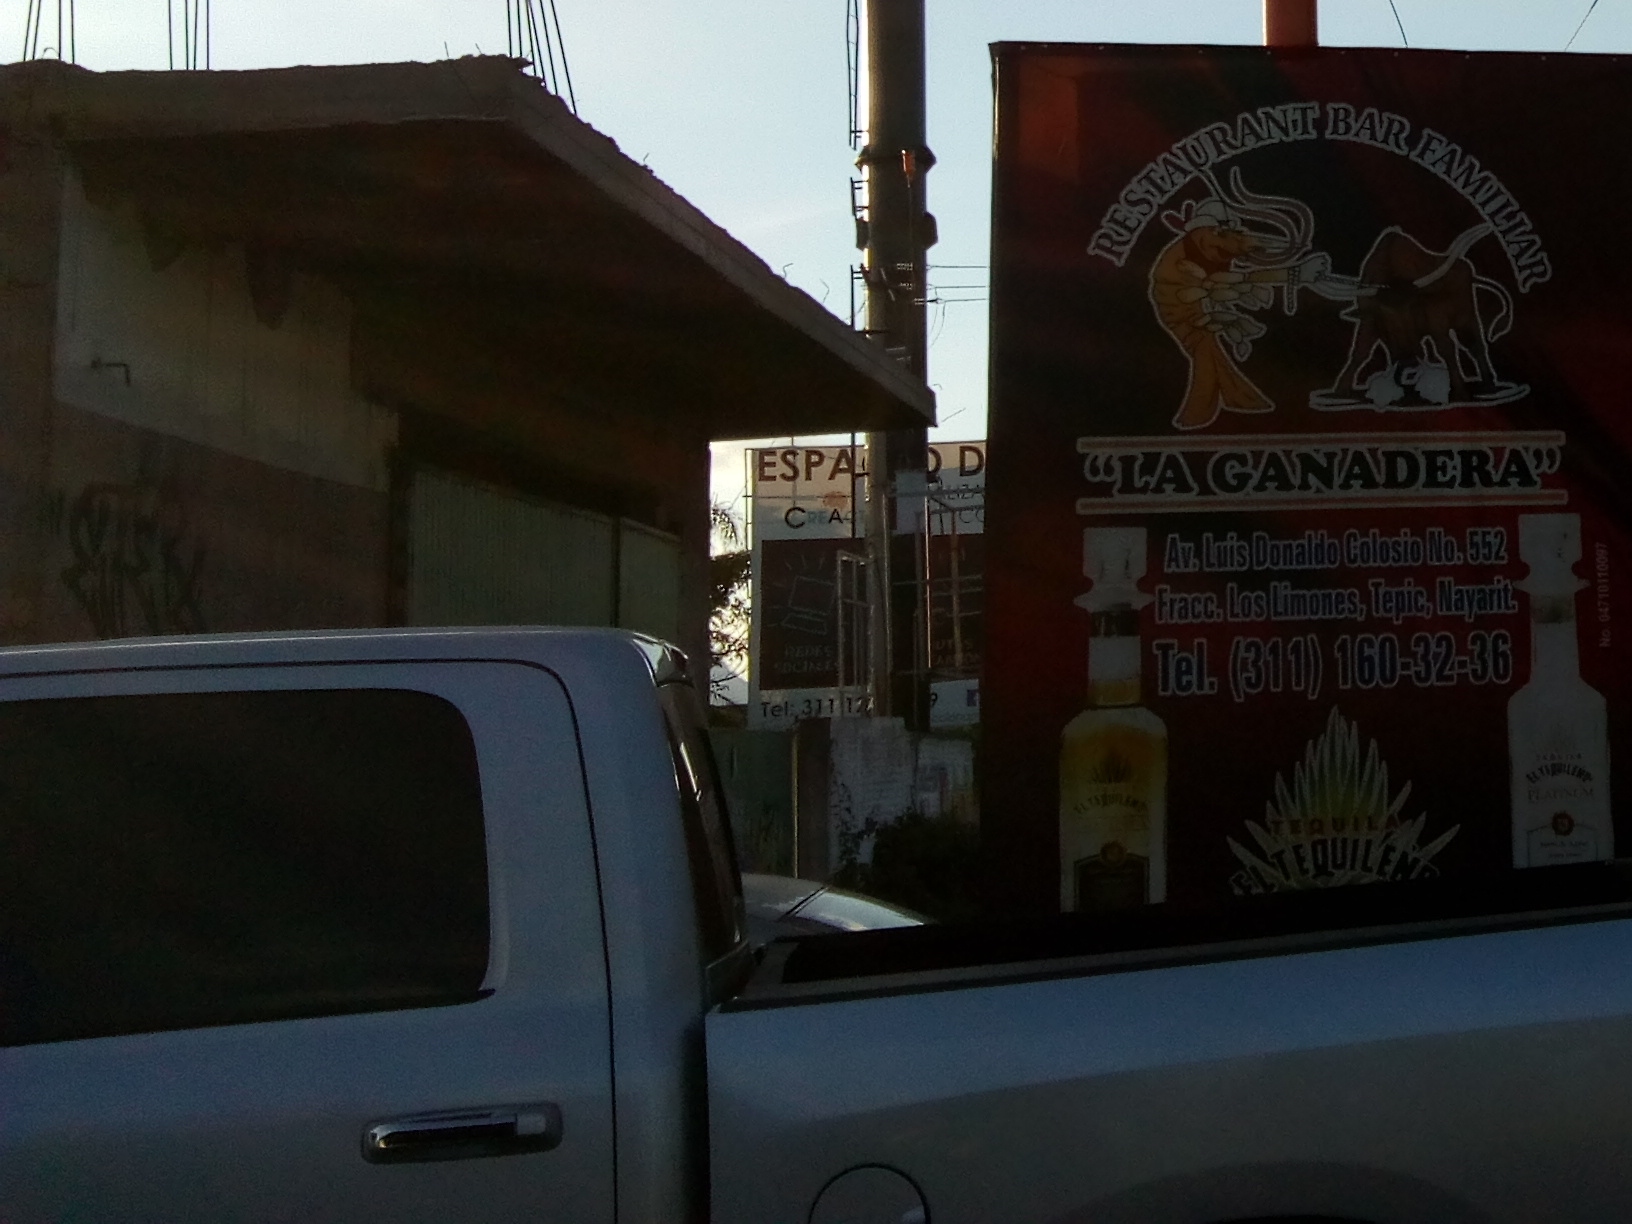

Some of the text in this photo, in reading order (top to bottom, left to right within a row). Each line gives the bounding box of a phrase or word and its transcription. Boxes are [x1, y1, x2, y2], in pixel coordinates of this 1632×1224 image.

[1087, 101, 1552, 294] RESTAURANT BAR FAMILIAR
[1165, 526, 1508, 574] Av. Luis Donaldo Colosio No. 552
[1153, 576, 1518, 624] Fracc. Los Limones, Tepic, Nayarit.
[1152, 629, 1514, 702] Tel. (311) 160-32-36
[1271, 814, 1400, 835] TEQUILA
